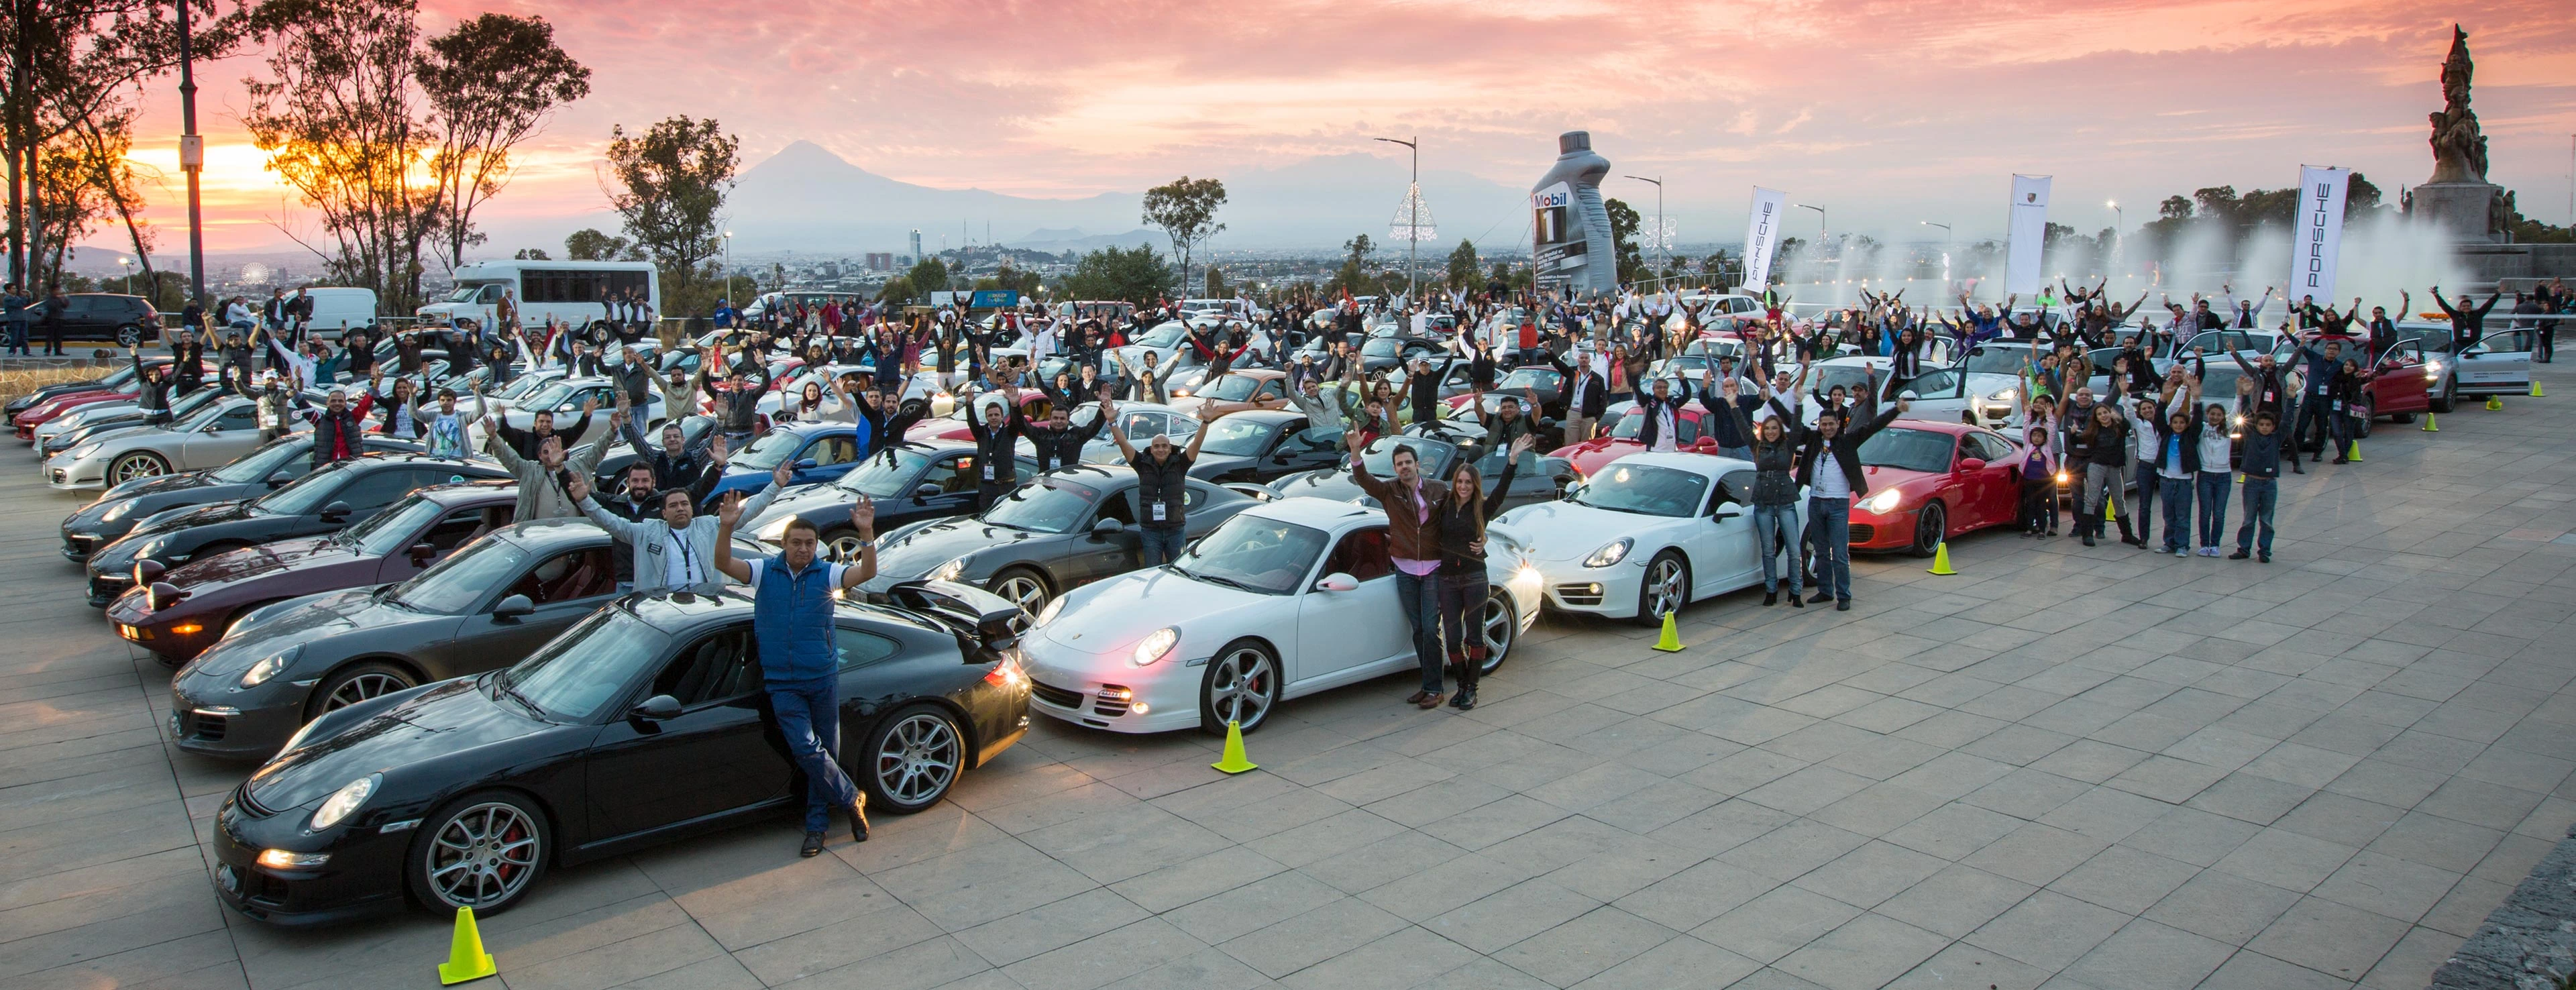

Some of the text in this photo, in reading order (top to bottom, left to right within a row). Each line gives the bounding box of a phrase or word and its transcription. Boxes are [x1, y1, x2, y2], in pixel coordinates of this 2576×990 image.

[1535, 192, 1566, 208] Mobil
[1543, 209, 1554, 241] 1
[1752, 201, 1773, 281] PORSCHE
[2307, 183, 2330, 288] PORSCHE
